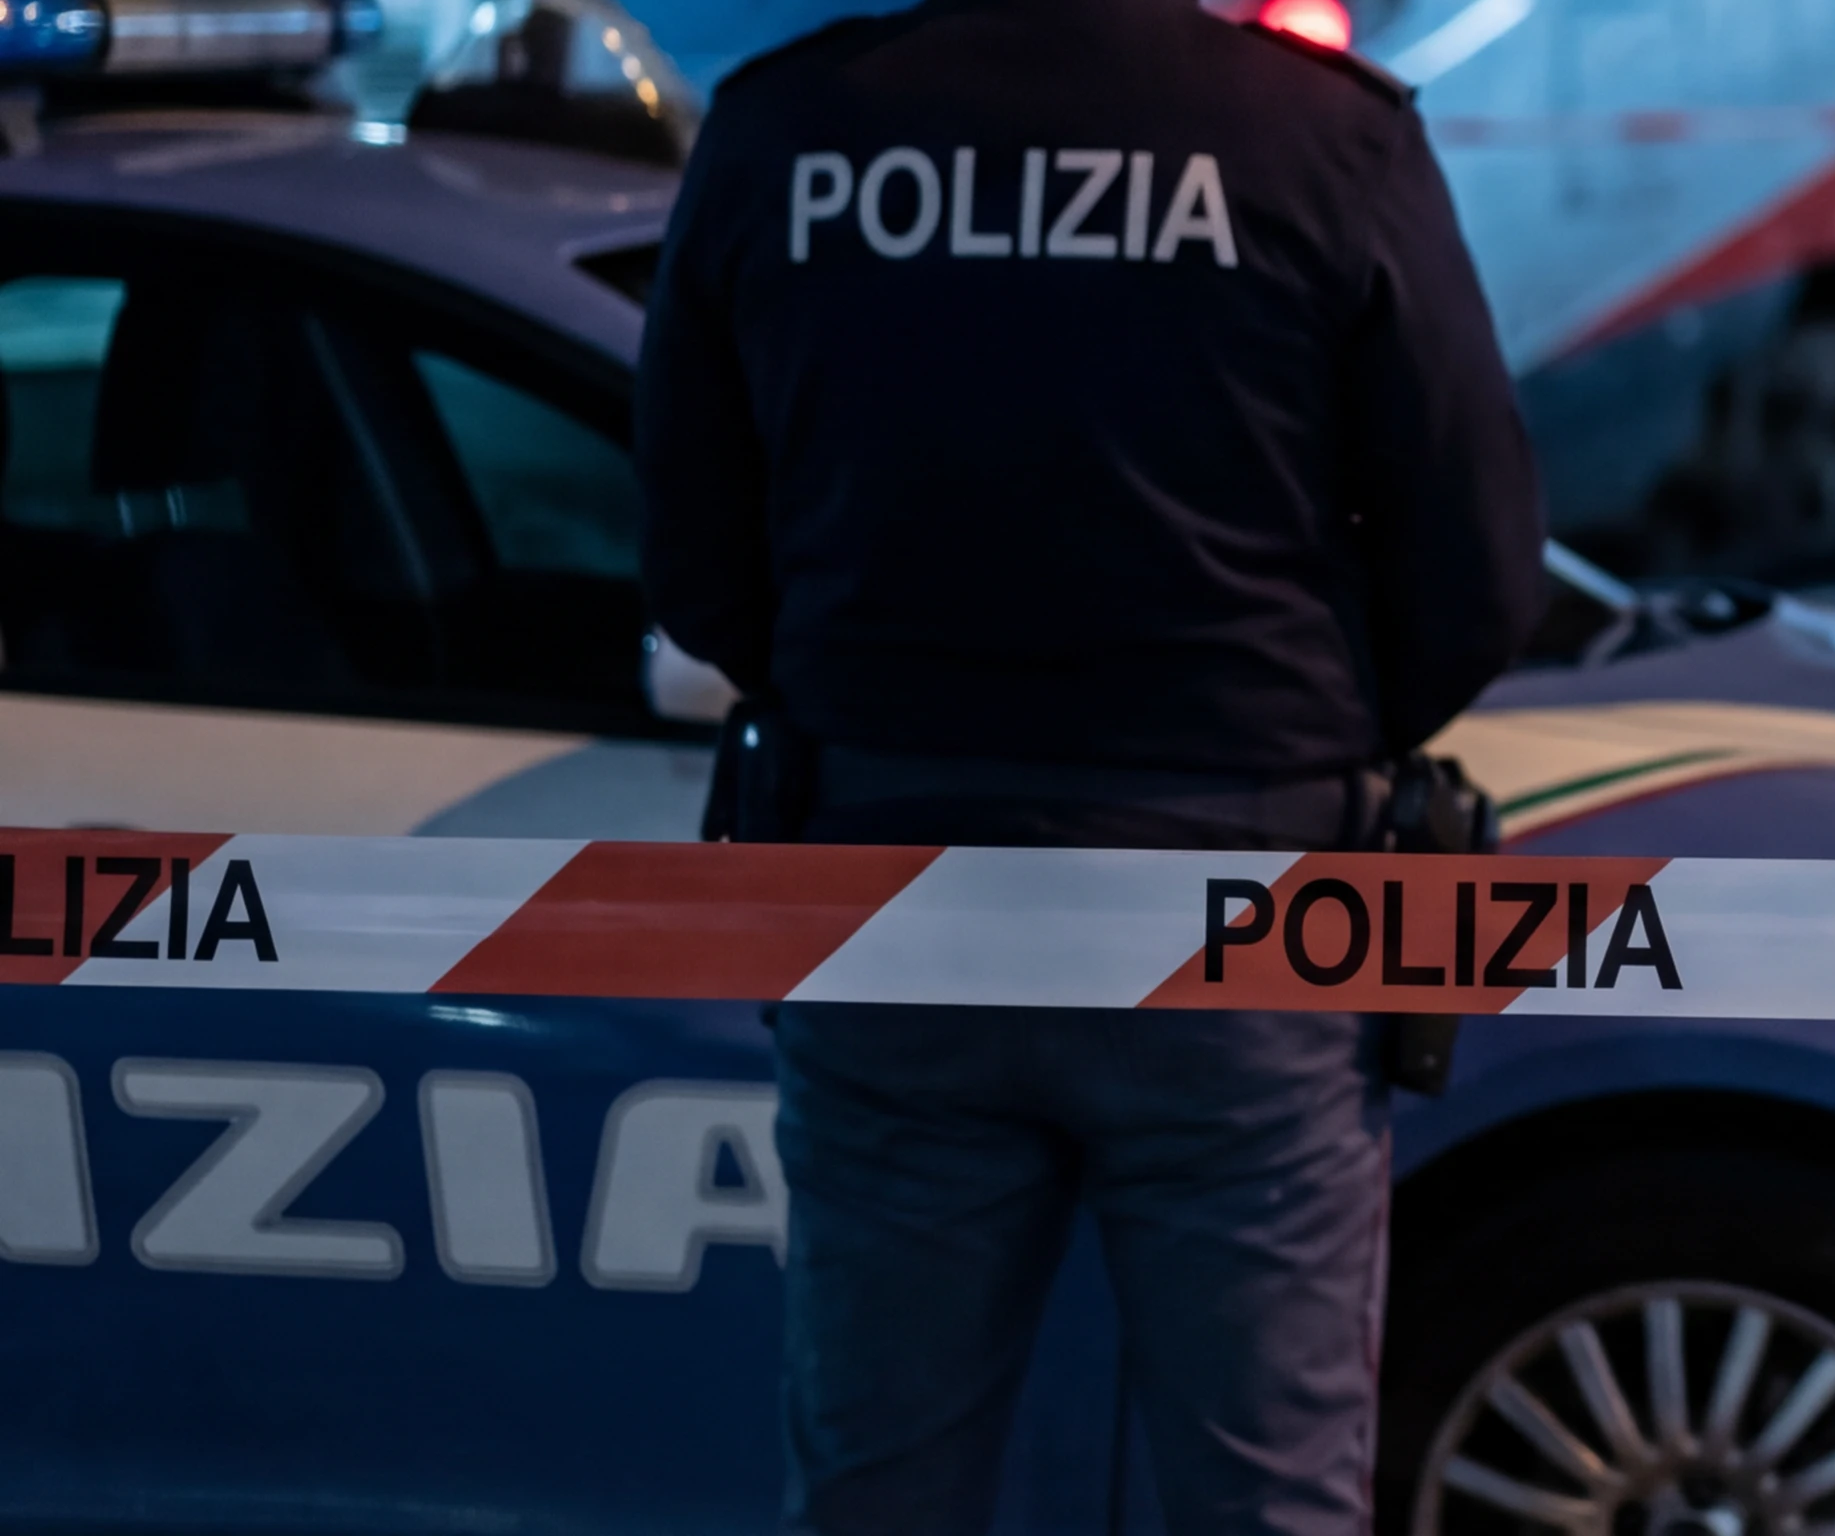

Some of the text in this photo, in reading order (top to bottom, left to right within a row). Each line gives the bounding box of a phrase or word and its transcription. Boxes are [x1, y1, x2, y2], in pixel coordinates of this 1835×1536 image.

[790, 146, 1239, 268] POLIZIA
[0, 854, 279, 962] LIZIA
[1202, 876, 1684, 991] POLIZIA
